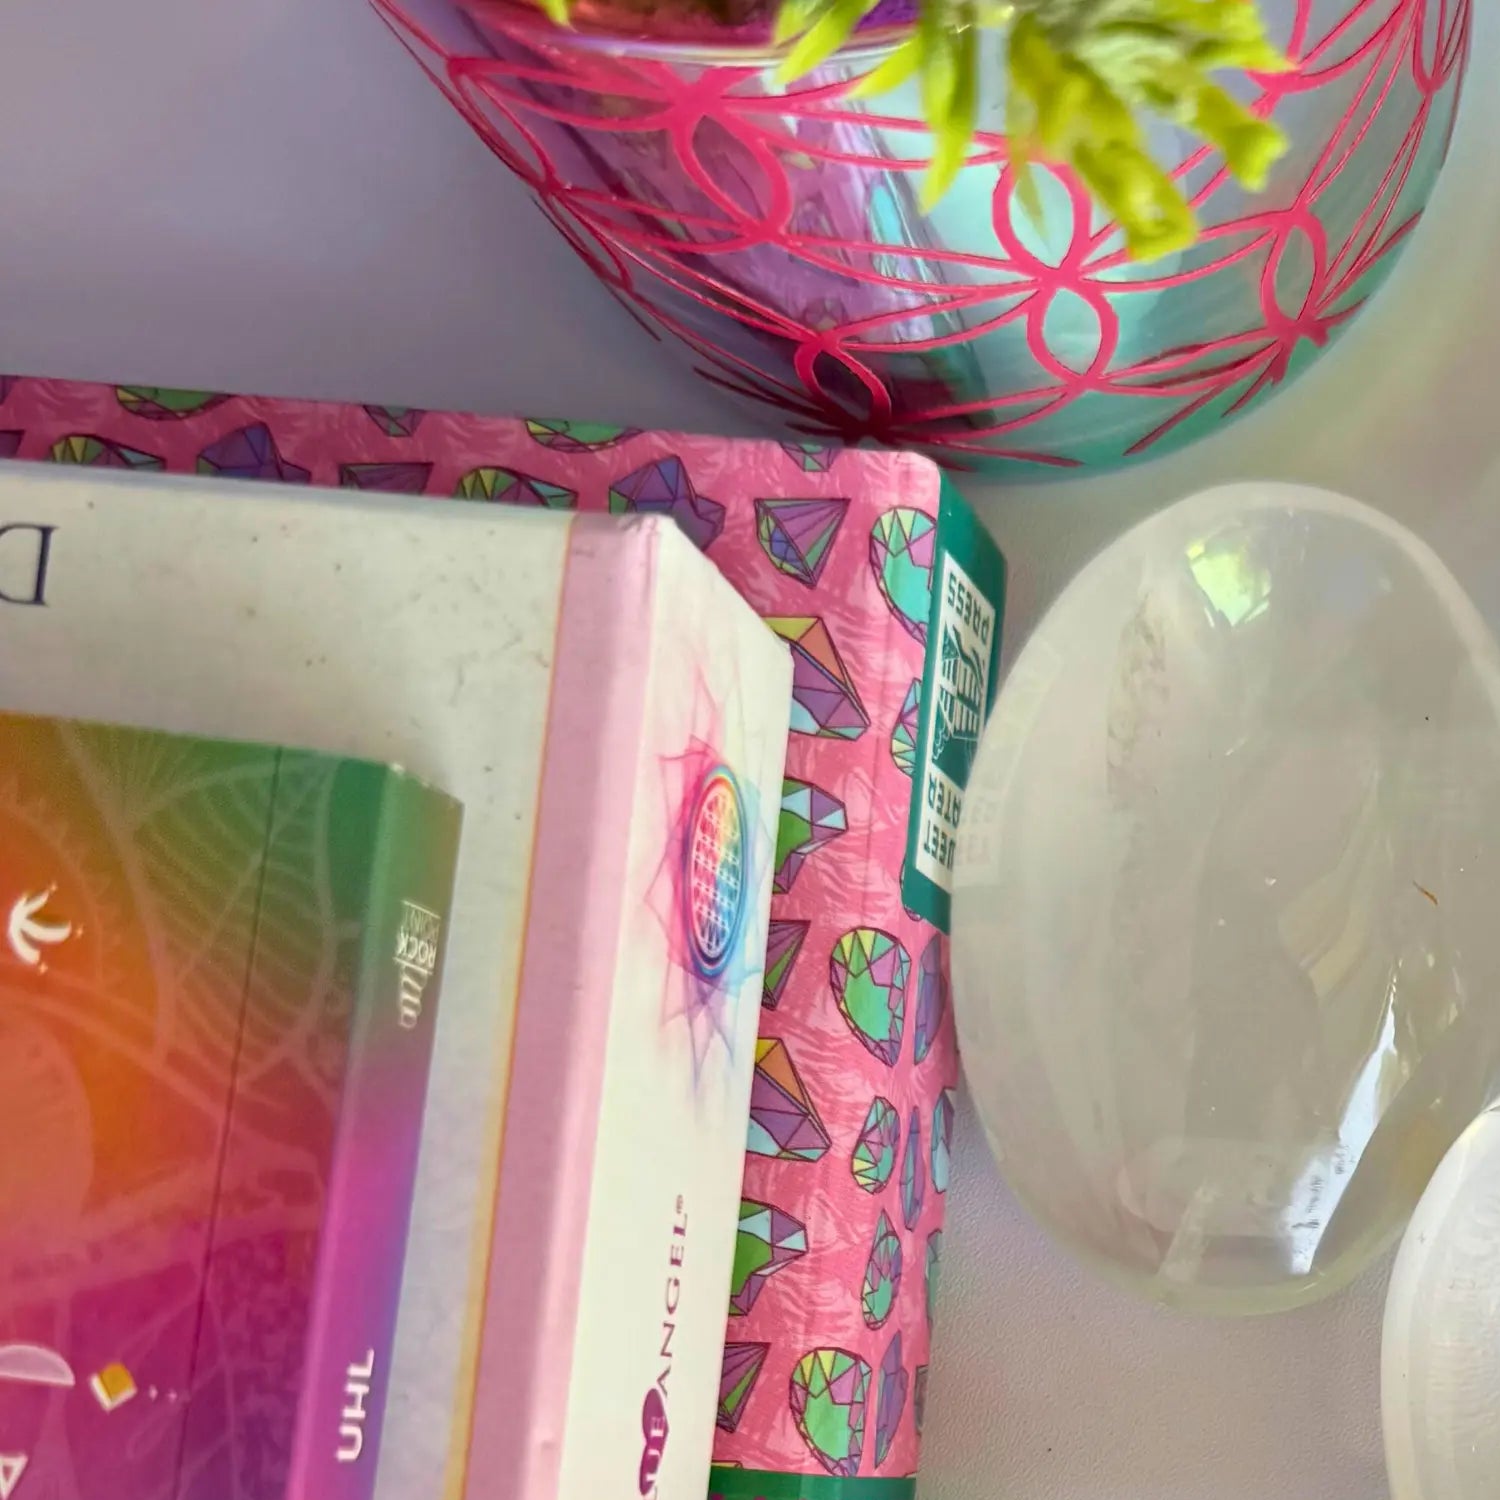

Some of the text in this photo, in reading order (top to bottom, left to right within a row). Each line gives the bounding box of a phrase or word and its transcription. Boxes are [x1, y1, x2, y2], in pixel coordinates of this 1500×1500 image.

[947, 572, 991, 647] PRESS
[928, 773, 962, 830] ATER
[396, 925, 437, 970] ROCK
[335, 1347, 376, 1463] UHL
